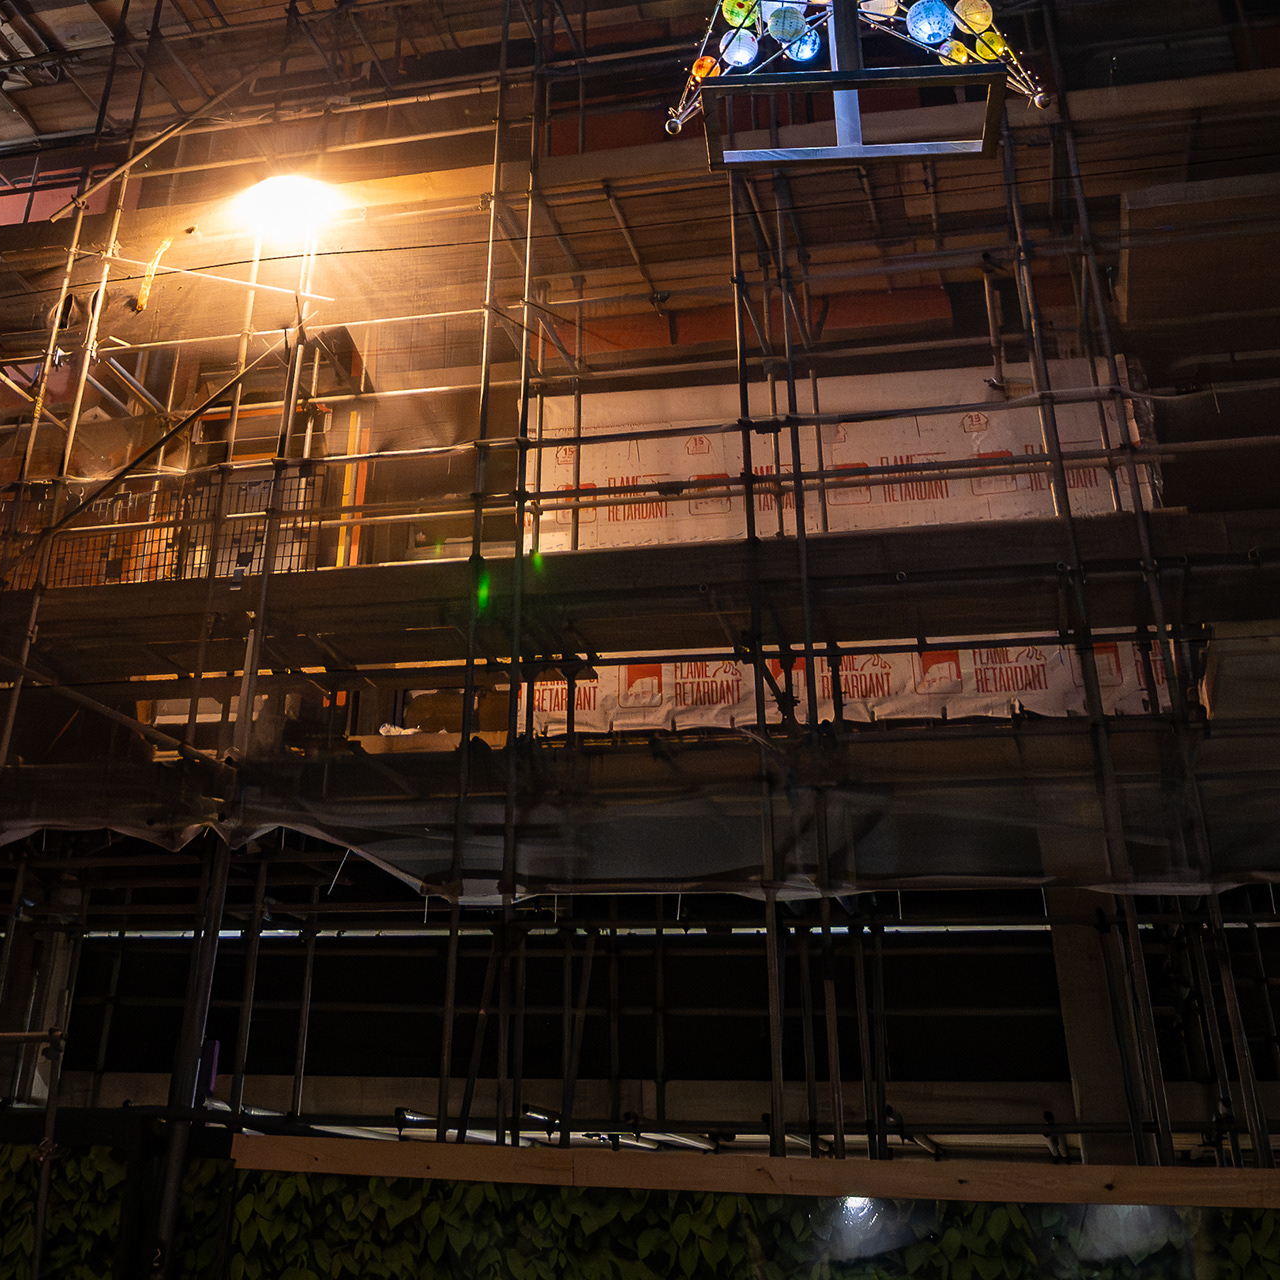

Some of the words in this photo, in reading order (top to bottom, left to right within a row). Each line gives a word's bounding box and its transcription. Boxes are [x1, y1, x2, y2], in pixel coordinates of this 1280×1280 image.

[674, 678, 742, 707] RETARDANT
[821, 672, 891, 700] RARDANT
[975, 664, 1048, 693] RETARDANT
[533, 686, 597, 712] RETARANT
